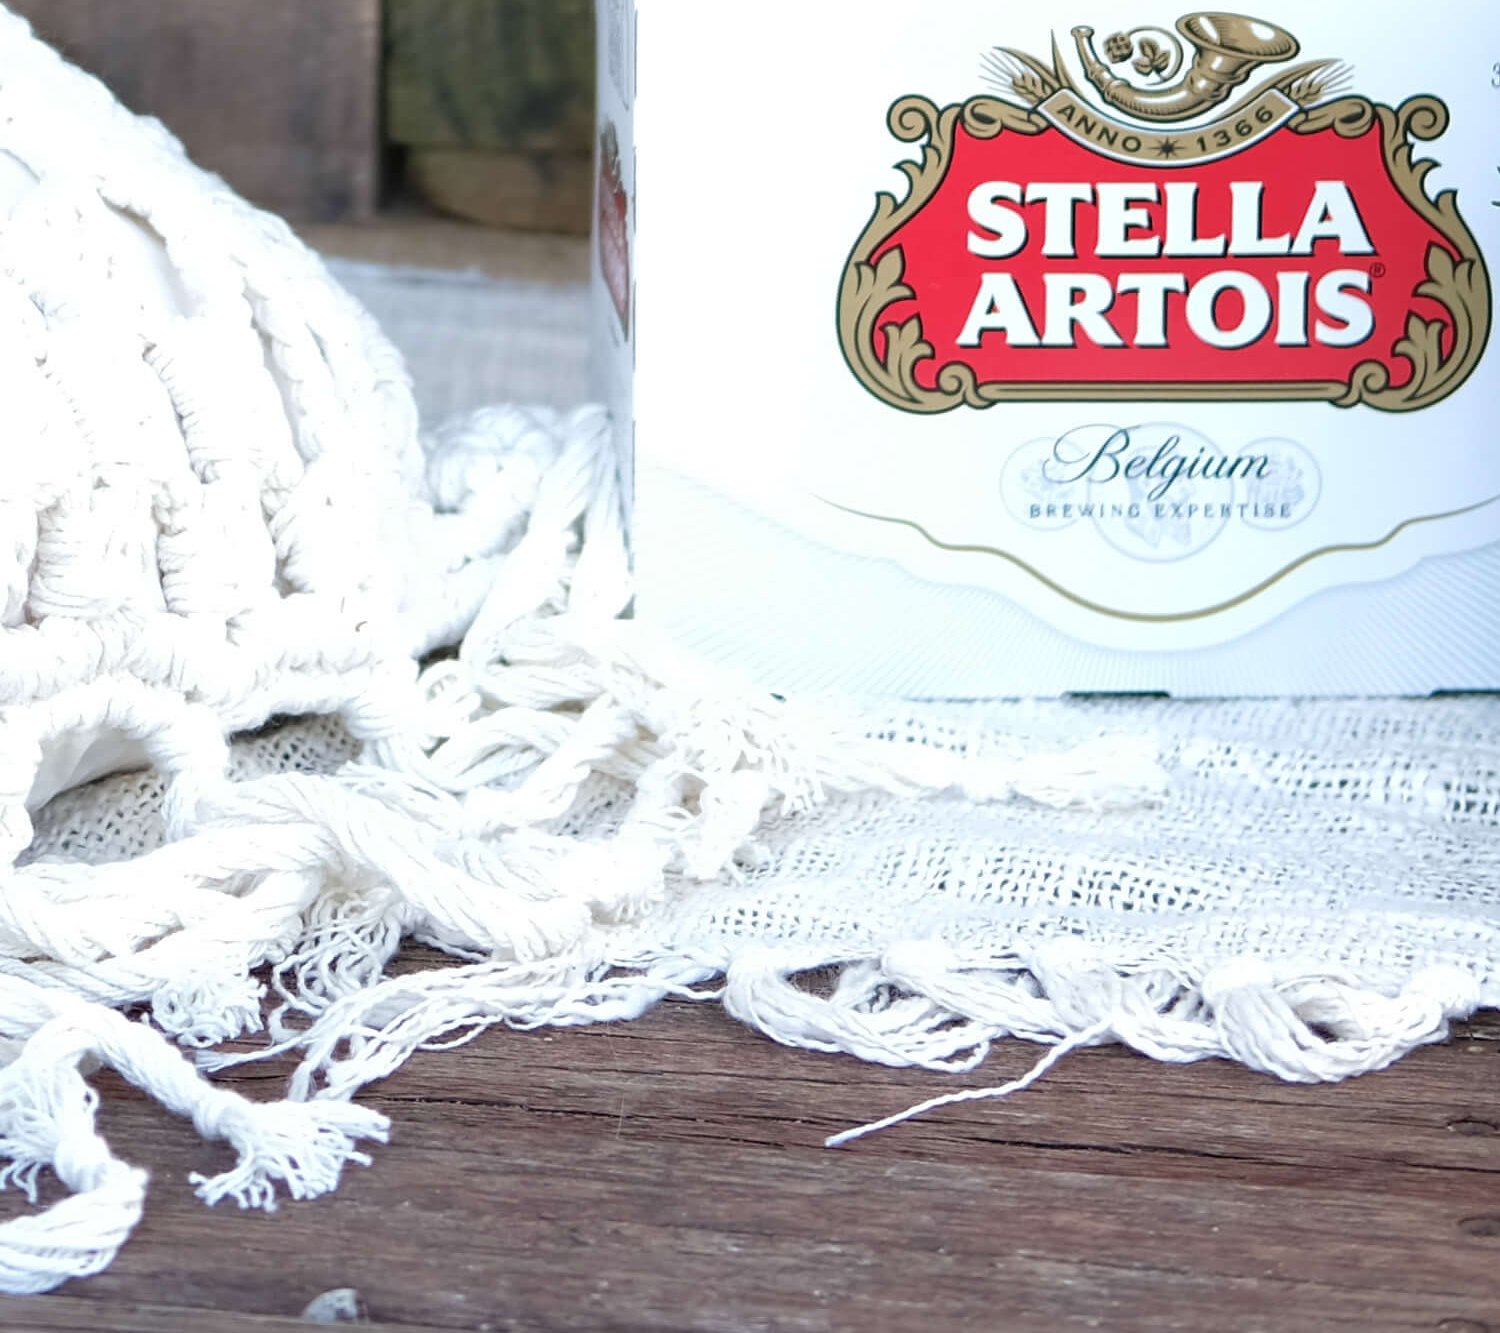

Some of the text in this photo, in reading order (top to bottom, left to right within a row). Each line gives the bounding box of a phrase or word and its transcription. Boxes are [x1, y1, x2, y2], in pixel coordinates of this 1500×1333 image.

[1056, 104, 1274, 154] ANNO 1366
[966, 179, 1378, 258] STELLA
[954, 269, 1376, 350] ARTOIS
[1041, 422, 1272, 501] Belgium
[1029, 502, 1292, 519] BREWING EXPERTISE
